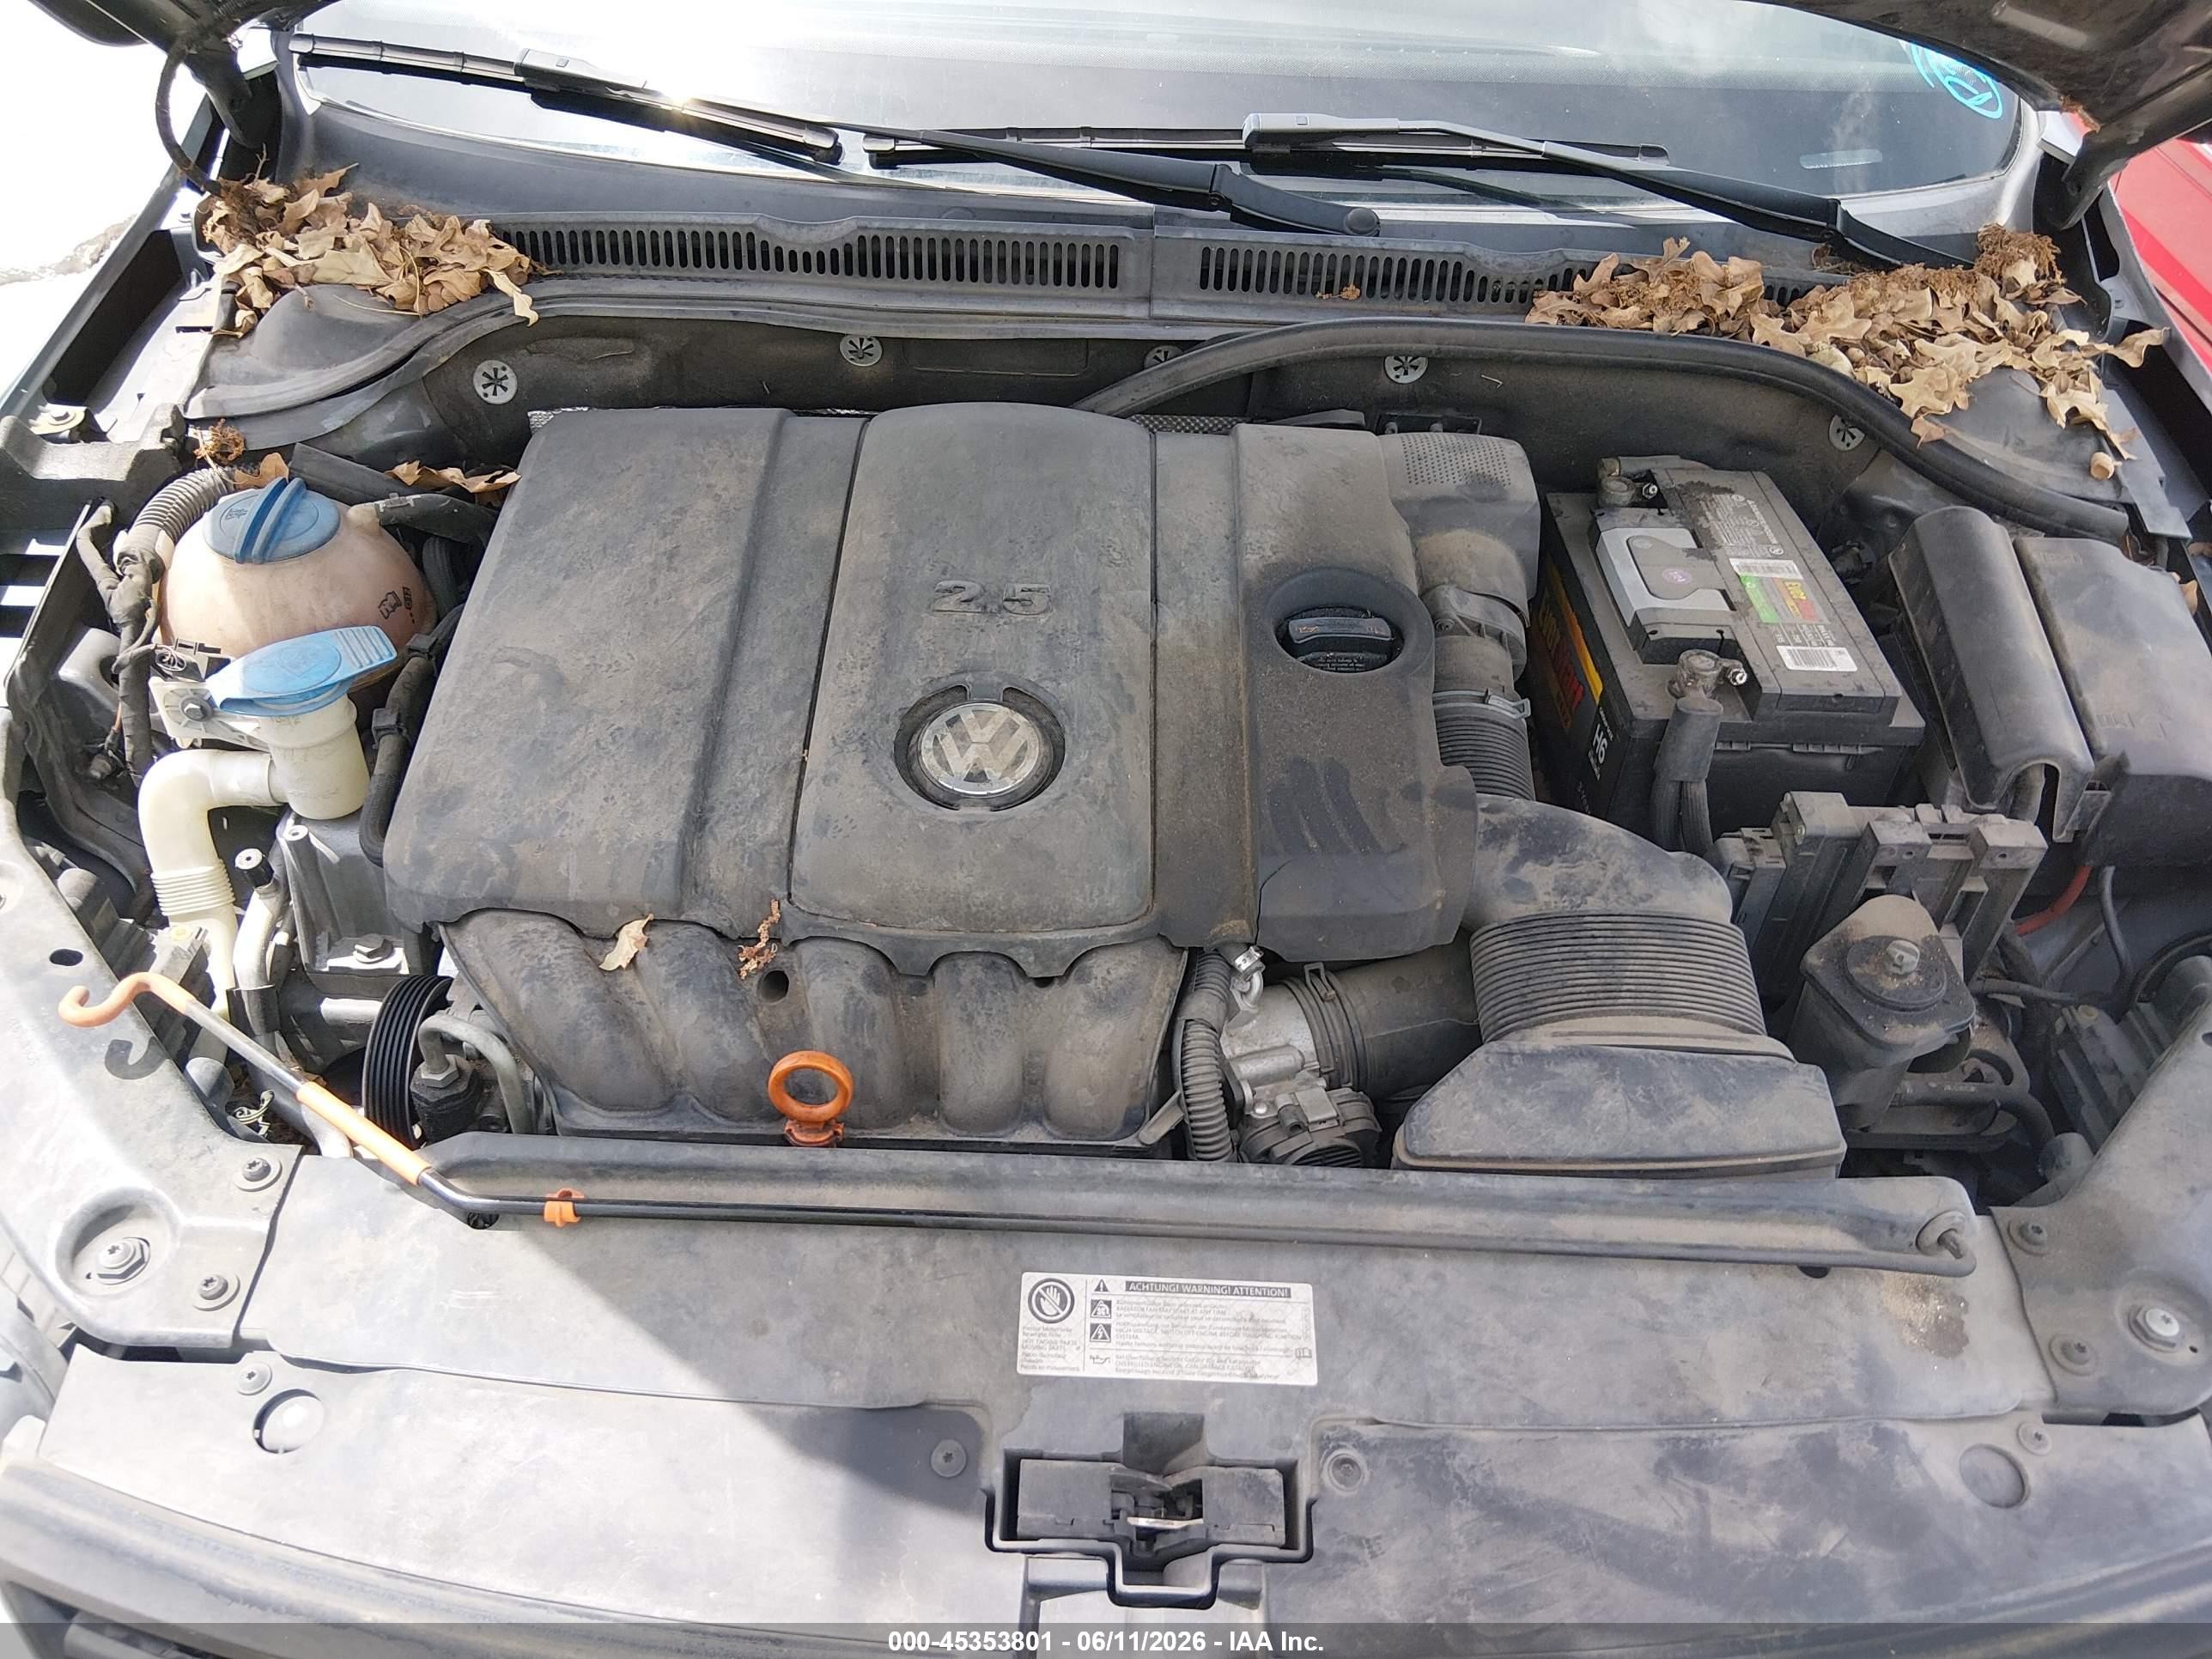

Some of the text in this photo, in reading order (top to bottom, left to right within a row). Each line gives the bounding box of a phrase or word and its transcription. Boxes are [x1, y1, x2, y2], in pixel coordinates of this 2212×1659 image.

[1592, 723, 1608, 764] H6
[1129, 1282, 1289, 1297] ACHTUNG! WARNING! ATTENTION!
